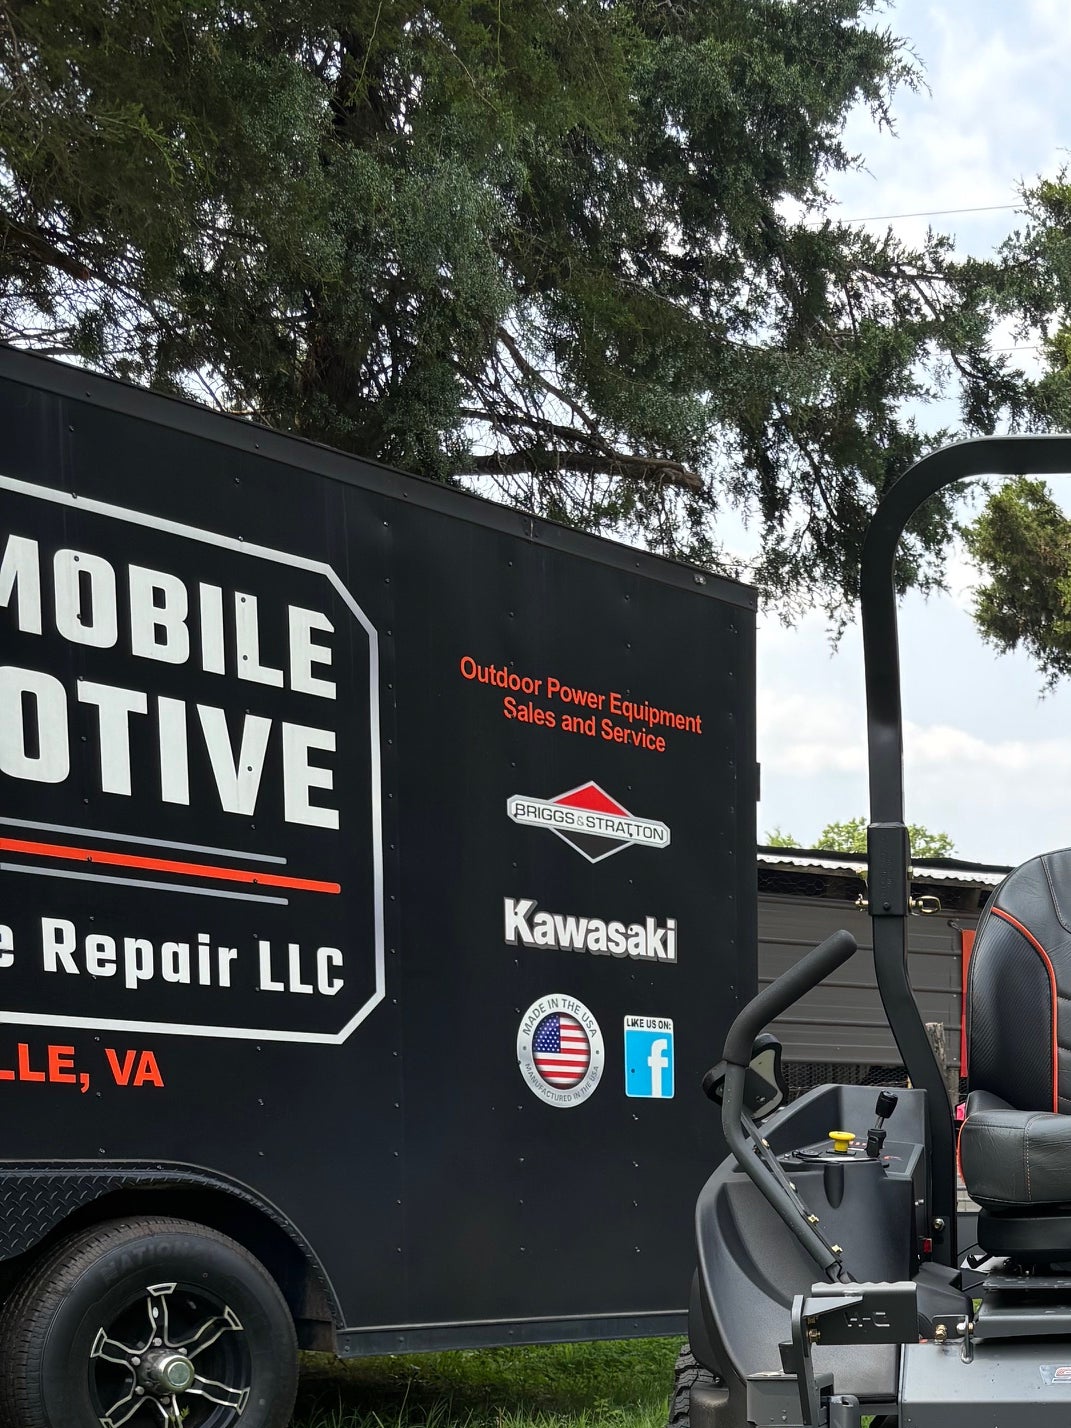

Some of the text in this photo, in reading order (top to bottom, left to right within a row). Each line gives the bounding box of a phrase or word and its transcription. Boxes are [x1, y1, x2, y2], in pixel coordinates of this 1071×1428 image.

[460, 656, 702, 734] Outdoor Power Equipment
[503, 696, 666, 752] Sales and Service
[515, 803, 664, 841] BRIGGS & STRATTON
[504, 897, 677, 963] Kawasaki
[41, 917, 238, 990] Repair
[258, 940, 344, 996] LLC
[522, 998, 597, 1037] MADE IN THE USA
[626, 1017, 671, 1030] LIKE US ON:
[104, 1048, 164, 1087] VA
[525, 1063, 599, 1102] MANUFACTURED IN THE USA
